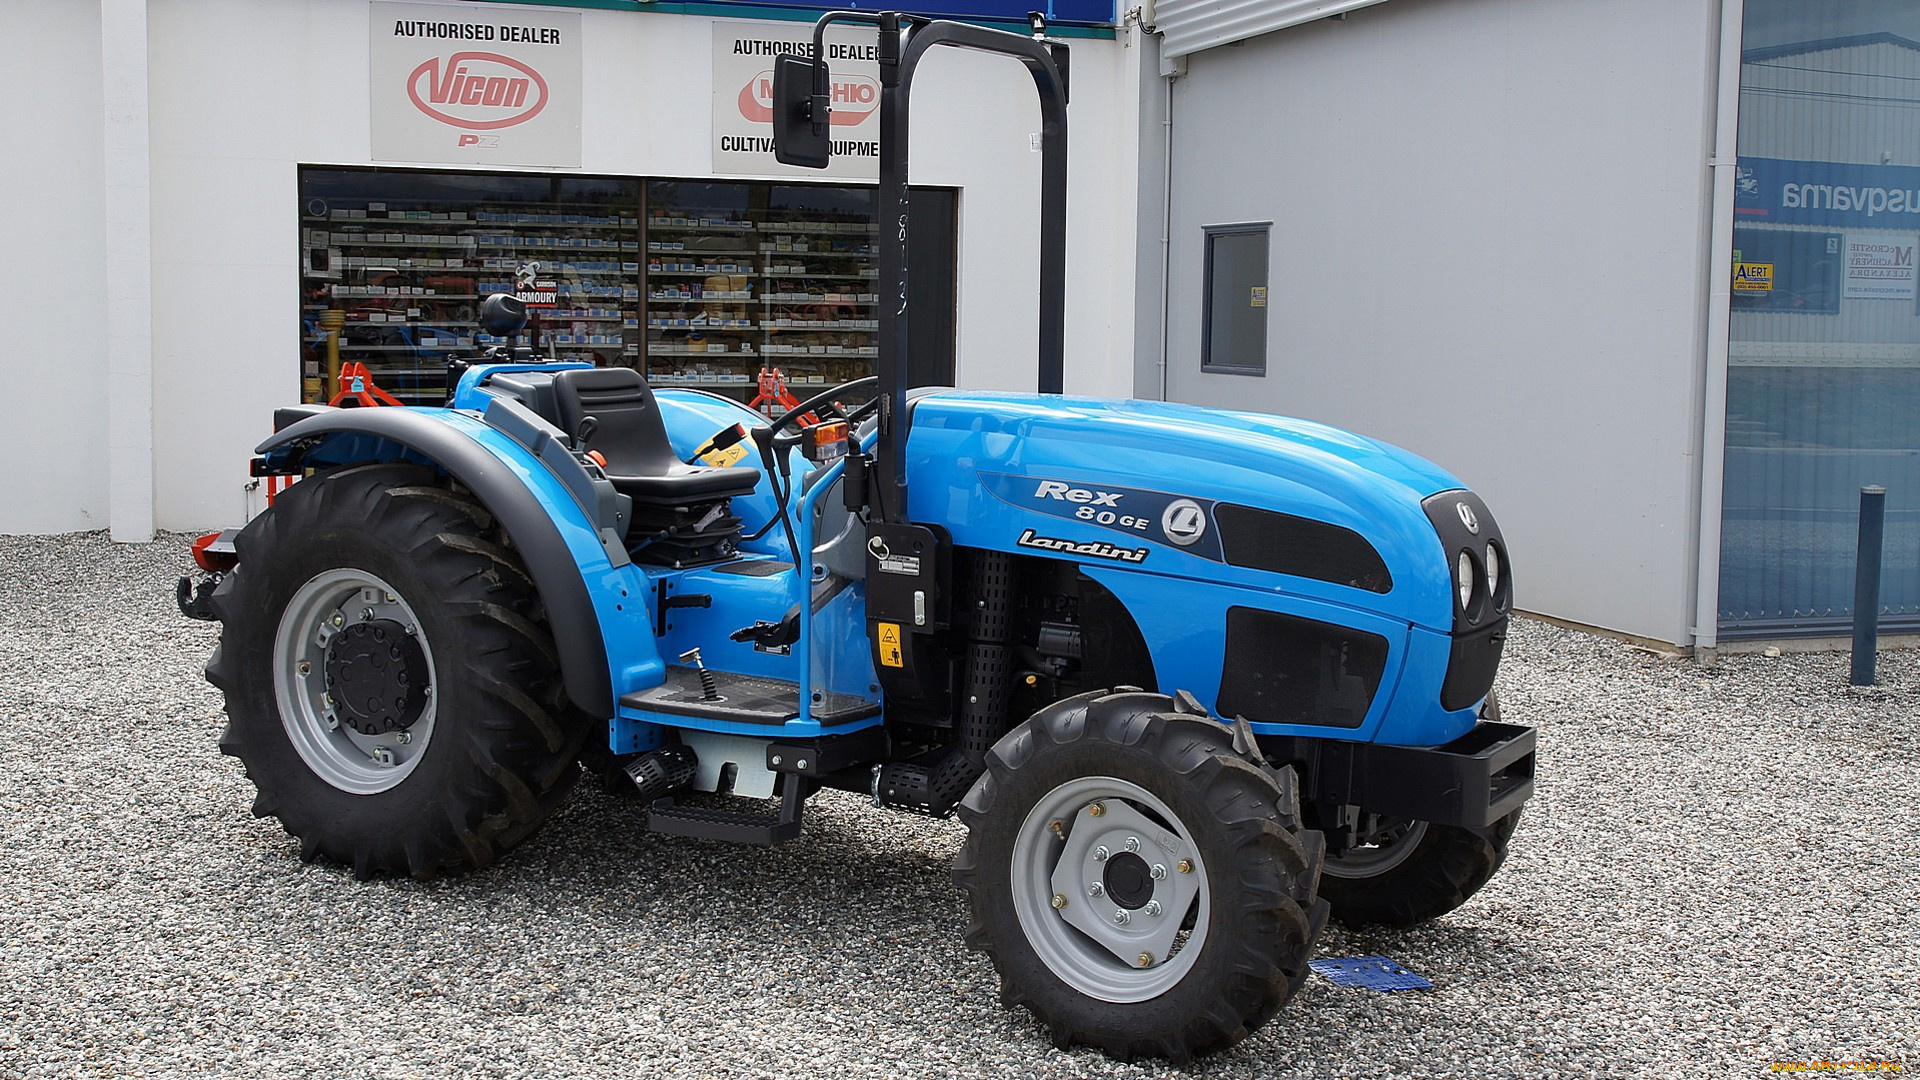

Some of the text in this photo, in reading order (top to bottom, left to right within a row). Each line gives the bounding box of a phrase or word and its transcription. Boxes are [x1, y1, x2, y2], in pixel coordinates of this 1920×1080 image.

[394, 20, 560, 45] AUTHORISED DEALER
[733, 39, 814, 58] AUTHORISE
[428, 52, 530, 108] Vicon
[760, 79, 875, 104] MHIO
[721, 135, 879, 157] CULTIVA QUIPME
[1735, 264, 1768, 281] ALERT
[516, 291, 557, 303] ARMOURY
[1034, 480, 1124, 508] Rex
[1018, 530, 1147, 562] Landini
